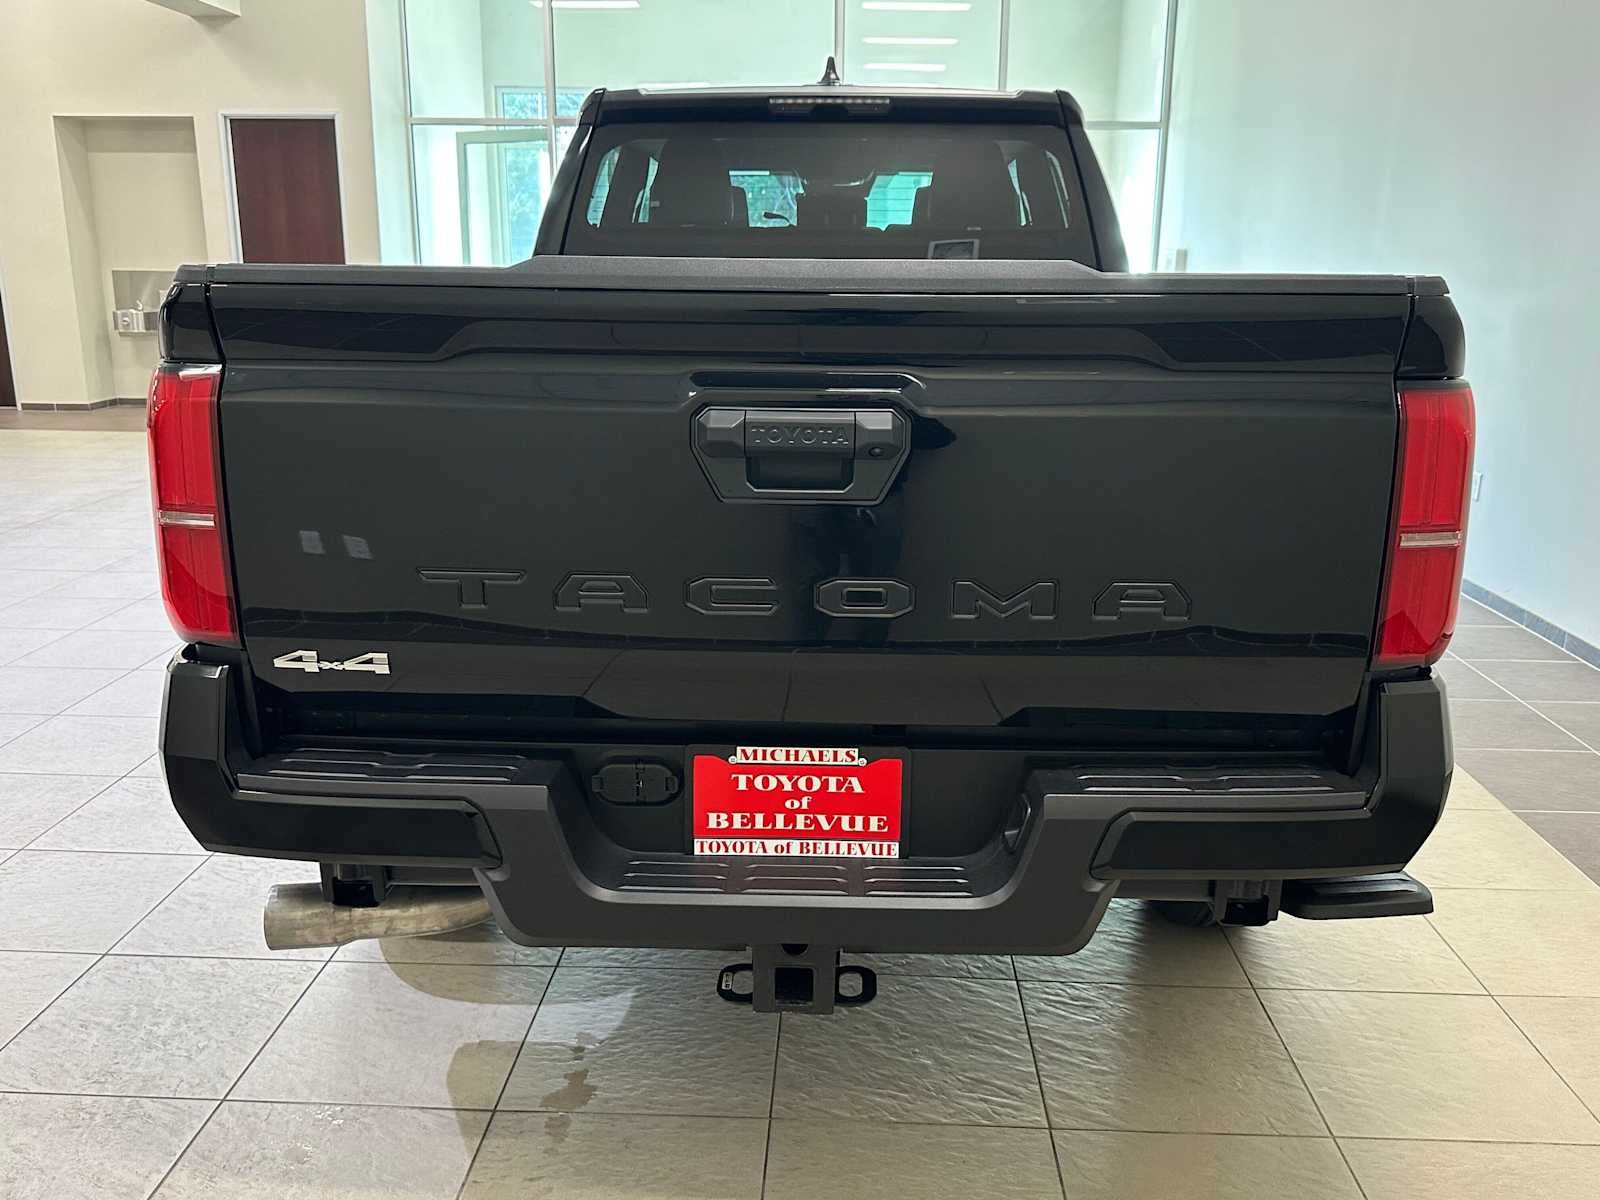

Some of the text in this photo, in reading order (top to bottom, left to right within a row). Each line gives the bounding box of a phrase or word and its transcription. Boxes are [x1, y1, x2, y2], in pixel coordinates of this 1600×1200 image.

[751, 427, 849, 445] TOYOTA
[416, 567, 1192, 621] TACOMA
[739, 748, 857, 763] MICHAELS
[731, 774, 865, 793] TOYOTA
[784, 796, 812, 810] of
[707, 812, 889, 832] BELLEVUE
[696, 840, 897, 857] TOYOTA of BELLEVUE
